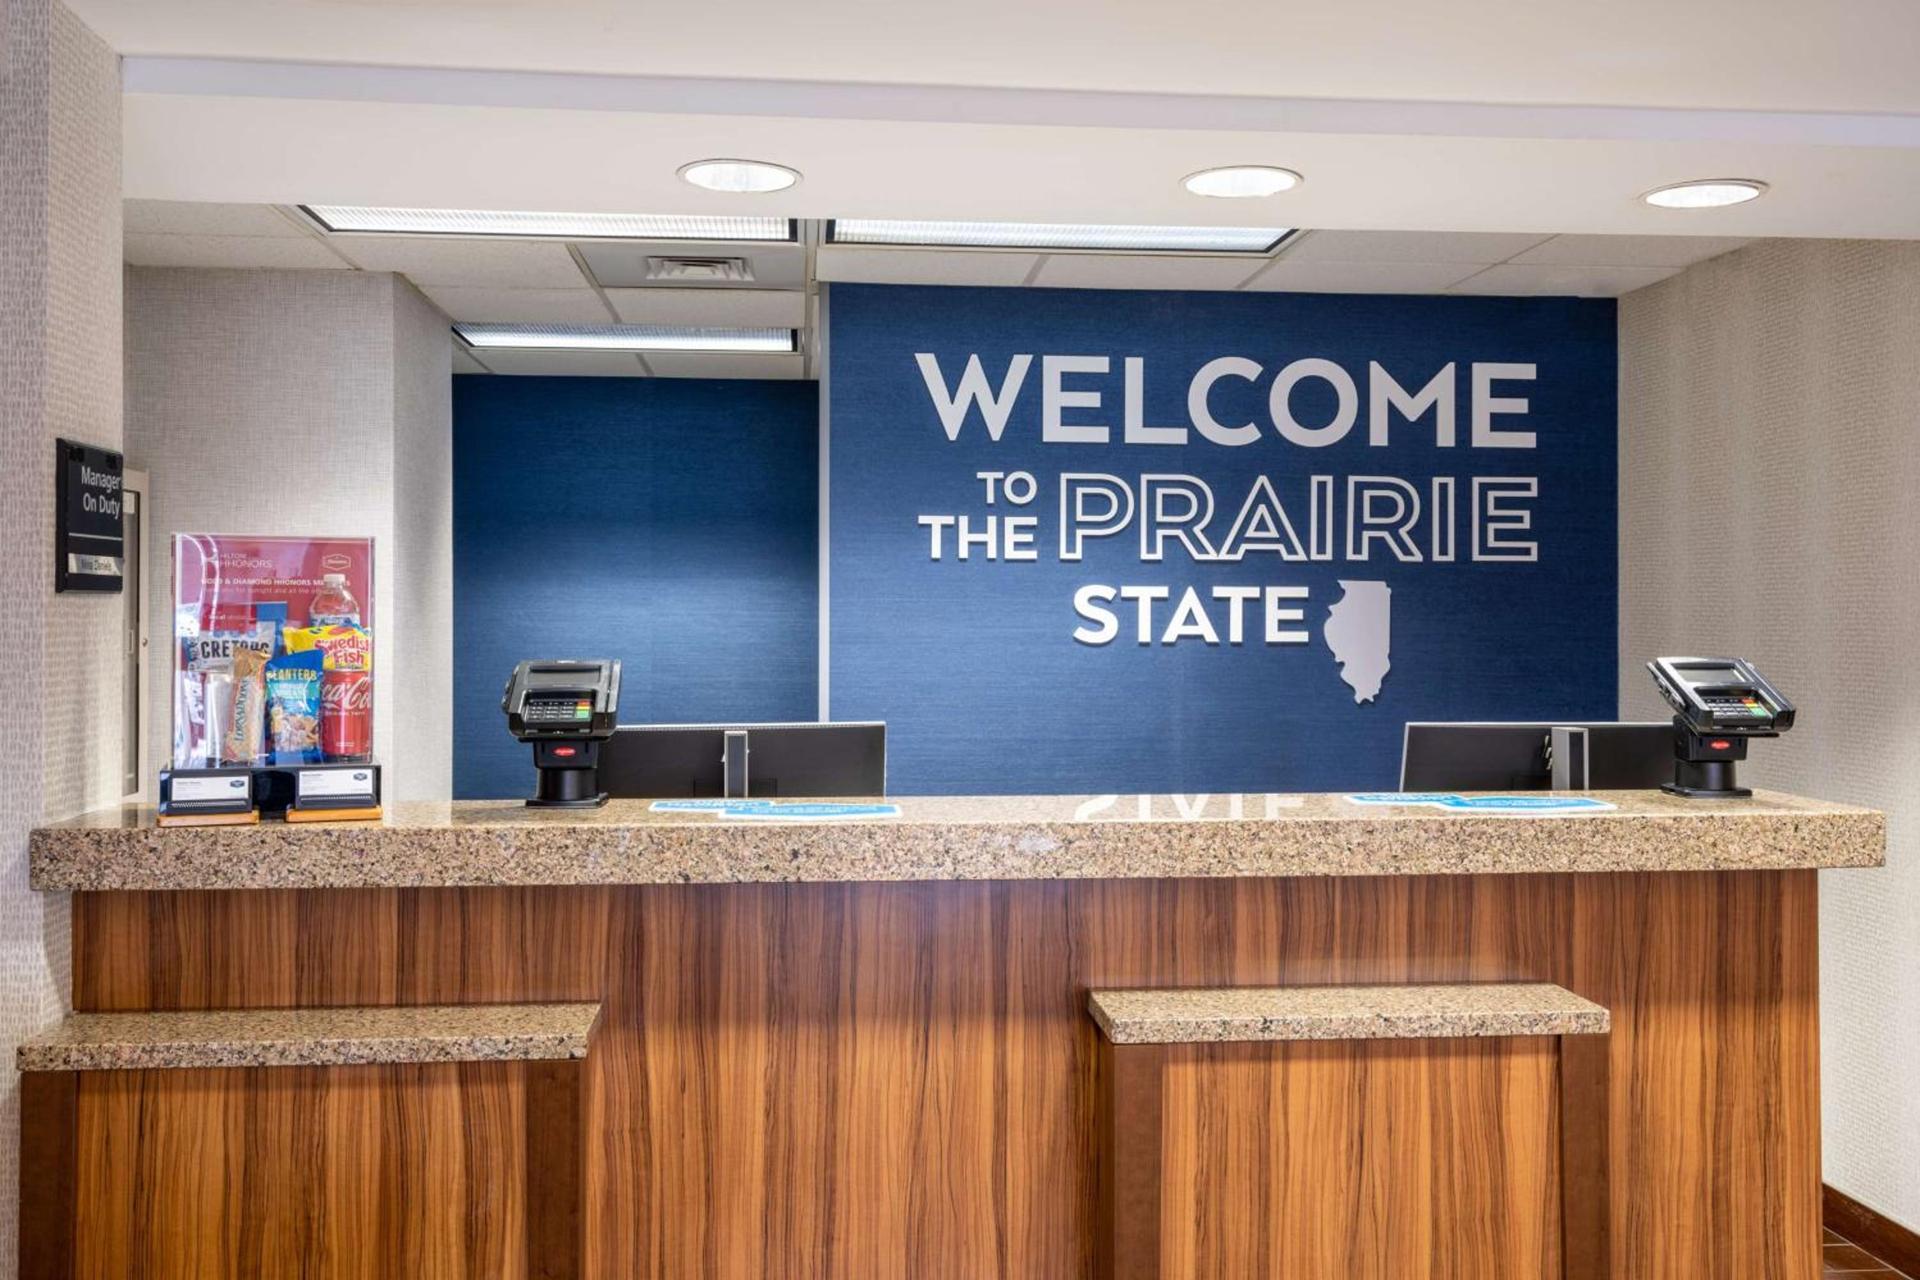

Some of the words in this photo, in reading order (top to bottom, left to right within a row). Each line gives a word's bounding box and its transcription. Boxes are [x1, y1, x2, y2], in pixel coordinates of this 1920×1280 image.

[914, 352, 1537, 448] WELCOME
[81, 465, 121, 493] Manager
[976, 471, 1037, 504] TO
[83, 492, 97, 512] On
[99, 494, 121, 519] Duty
[917, 514, 1038, 560] THE
[1058, 472, 1539, 562] PRAIRIE
[1072, 584, 1309, 645] STATE
[333, 650, 365, 665] Fish
